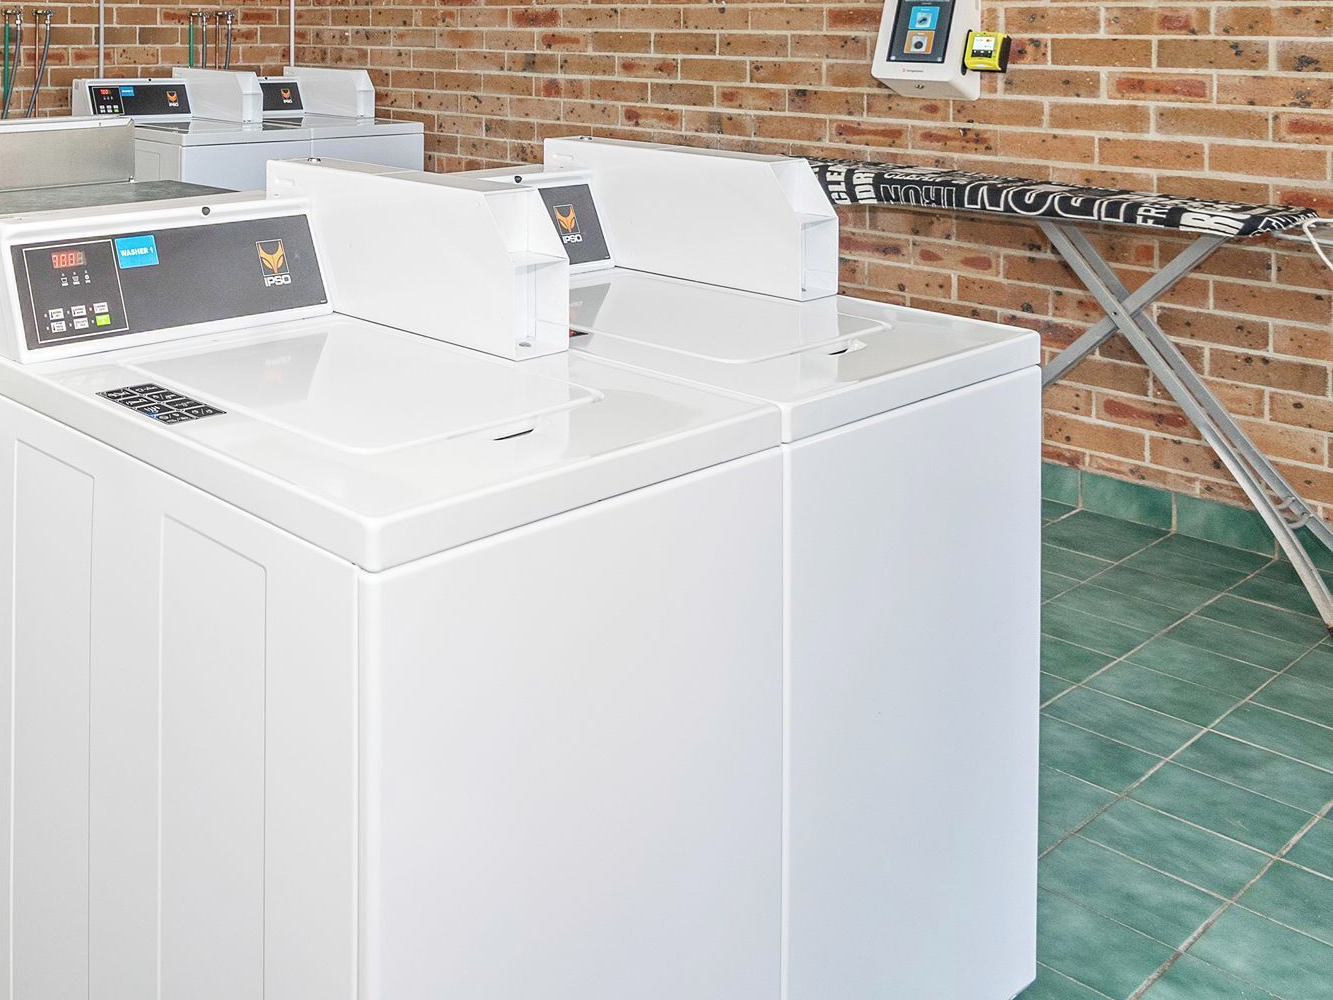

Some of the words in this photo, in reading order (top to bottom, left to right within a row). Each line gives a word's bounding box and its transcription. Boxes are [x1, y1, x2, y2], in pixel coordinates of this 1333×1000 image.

[562, 234, 582, 244] IPSO
[120, 248, 148, 257] WASHER
[264, 275, 292, 287] IPSO
